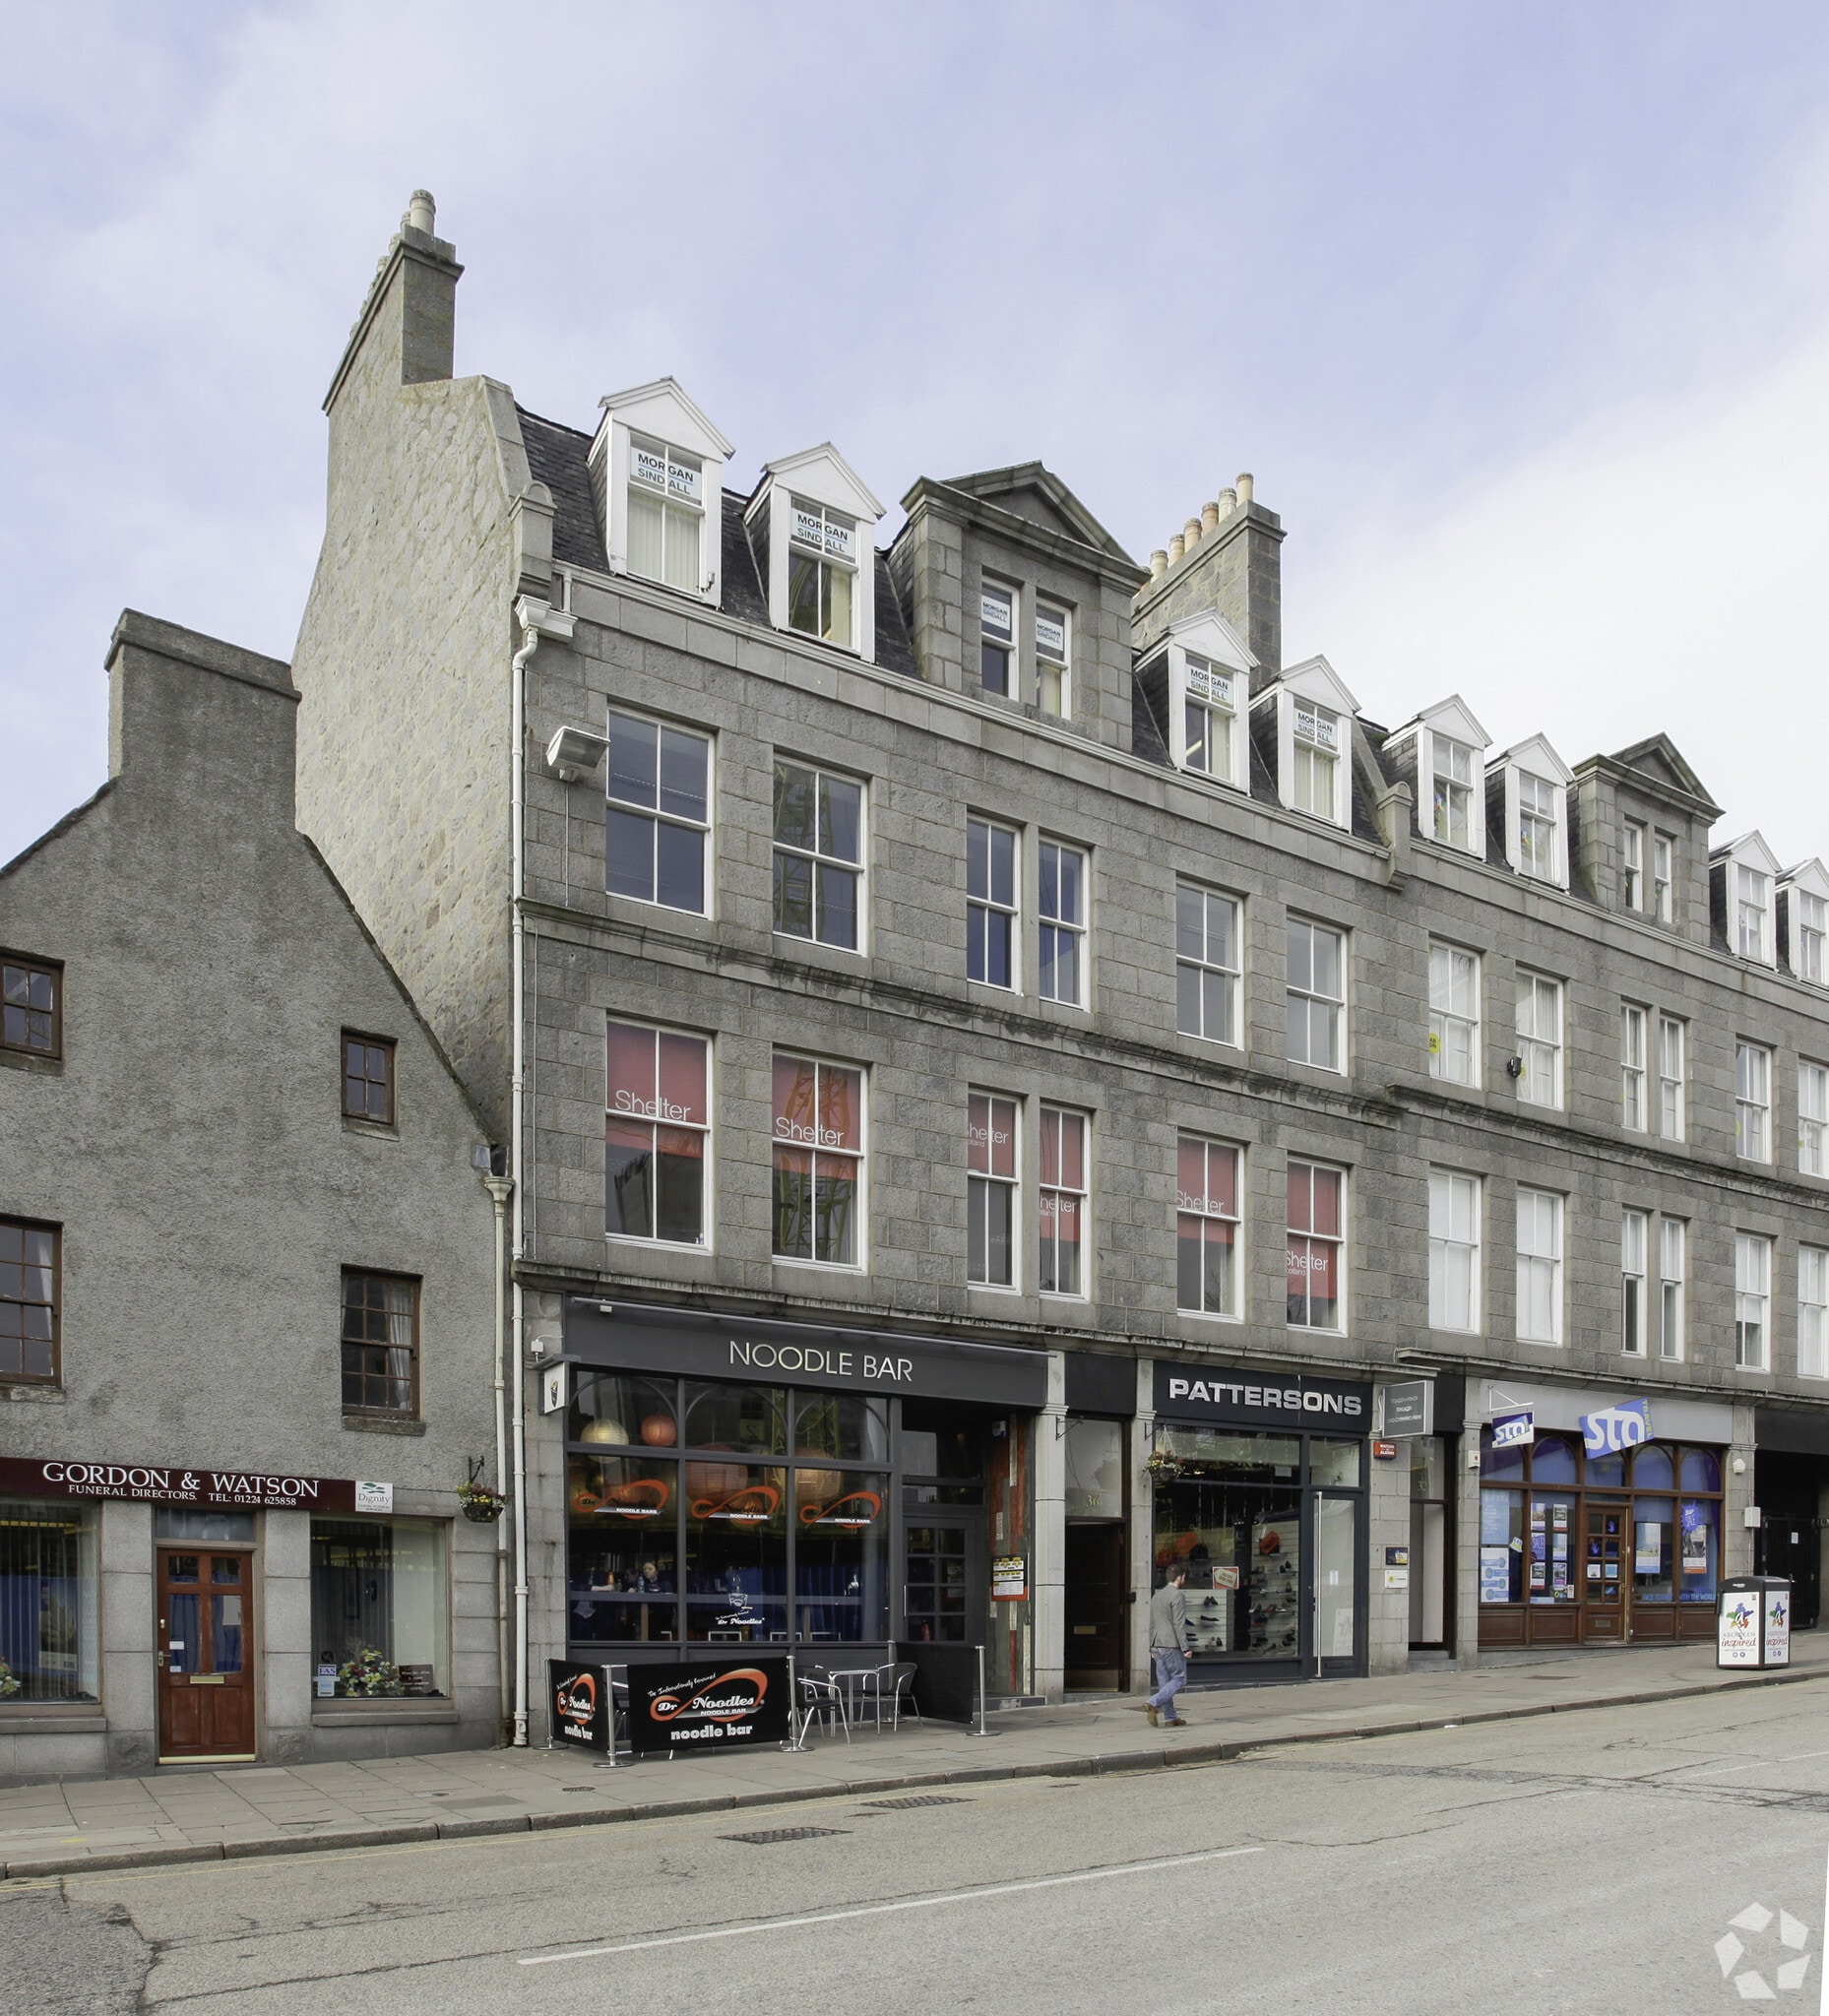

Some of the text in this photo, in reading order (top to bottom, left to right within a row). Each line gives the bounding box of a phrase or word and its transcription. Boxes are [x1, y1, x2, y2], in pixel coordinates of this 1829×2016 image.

[638, 454, 693, 482] MORGAN
[638, 468, 691, 495] SINDALL
[797, 514, 848, 540] MORGAN
[797, 528, 846, 552] SINDALL
[982, 601, 1008, 616] MORGAN
[1037, 623, 1060, 637] MORGAN
[1190, 668, 1229, 690] MORGAN
[1190, 680, 1227, 701] SINDALL
[1297, 712, 1333, 733] MORGAN
[1297, 724, 1331, 743] SINDALL
[615, 1090, 691, 1121] Shelter
[776, 1116, 845, 1146] Sheter
[729, 1340, 913, 1382] NOODLE BAR
[1168, 1378, 1362, 1416] PATTERSONS
[42, 1463, 319, 1497] GORDON & WATSON
[69, 1484, 297, 1506] FUNERAL DIRECTORS. TEL: 01224 625858
[358, 1492, 390, 1505] Dignity
[1086, 1494, 1100, 1507] 36
[1721, 1638, 1756, 1649] inspired
[658, 1695, 755, 1712] Dr Noodles
[670, 1723, 753, 1740] noodle bar
